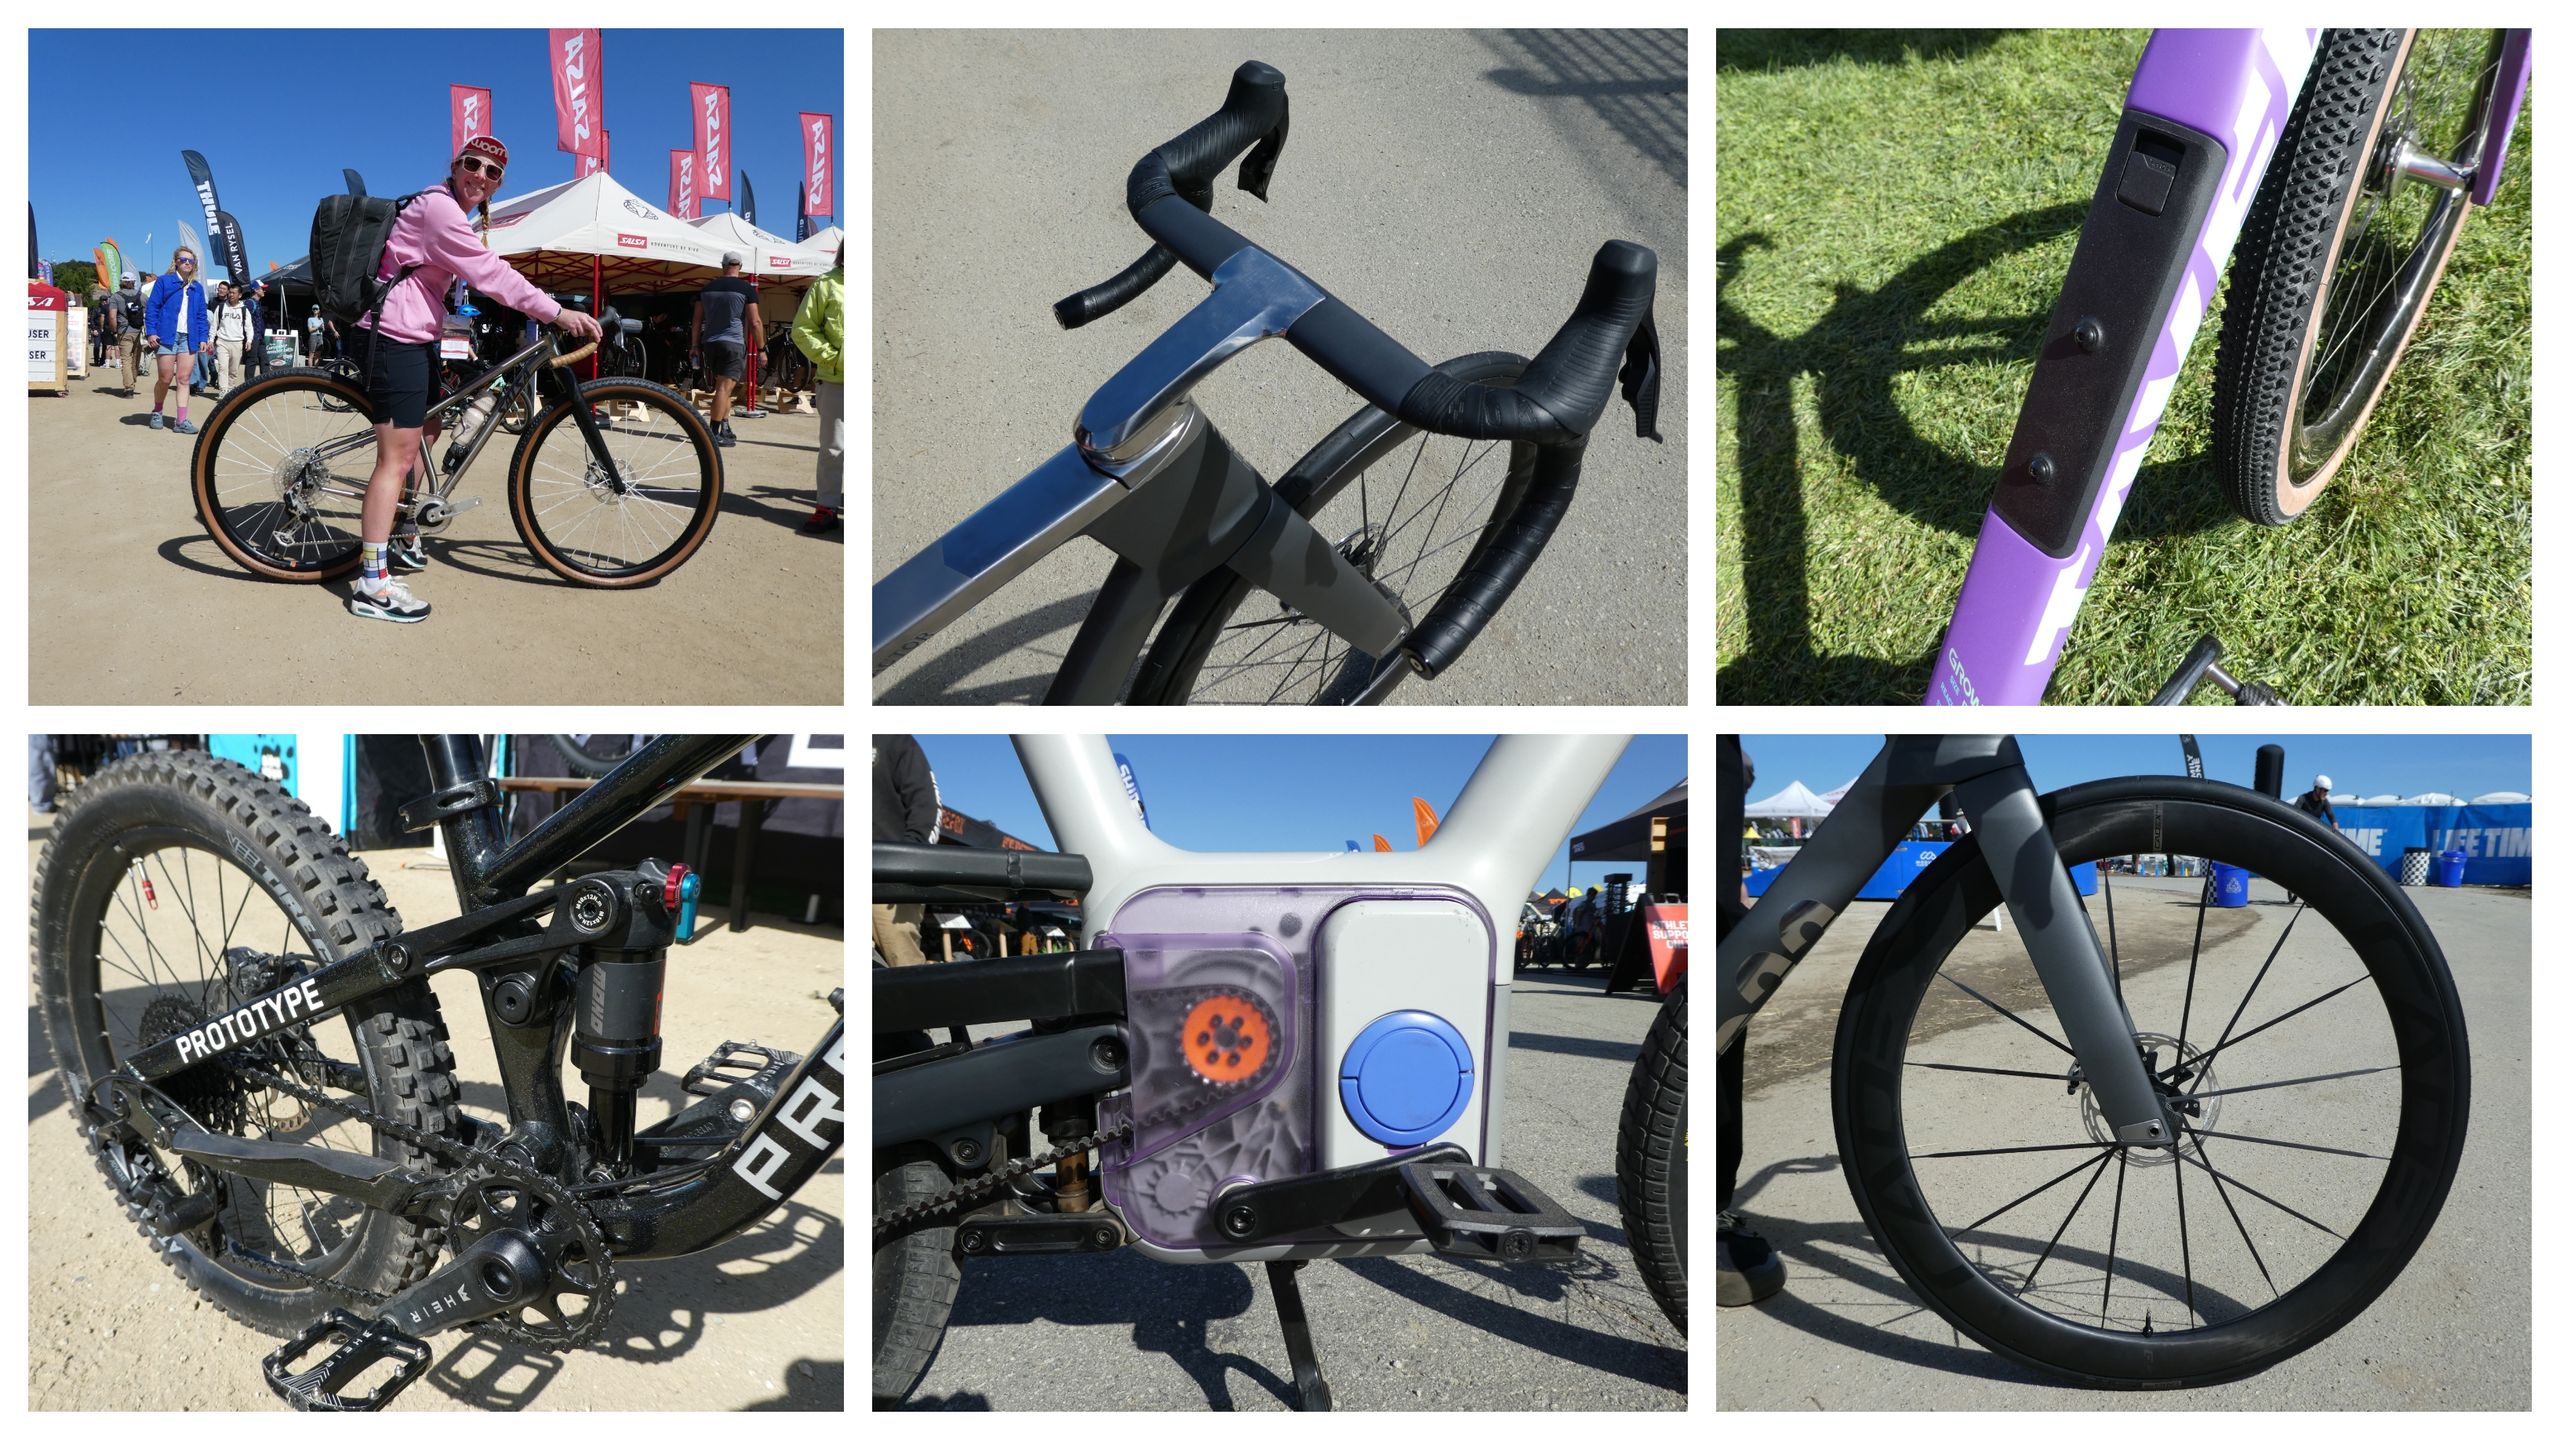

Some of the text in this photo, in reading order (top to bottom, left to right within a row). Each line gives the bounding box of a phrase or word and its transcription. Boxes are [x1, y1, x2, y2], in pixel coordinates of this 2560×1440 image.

[196, 180, 221, 236] THULE
[225, 222, 244, 275] VAN RYSEL
[618, 236, 646, 247] SALSA
[176, 978, 324, 1064] PROTOTYPE
